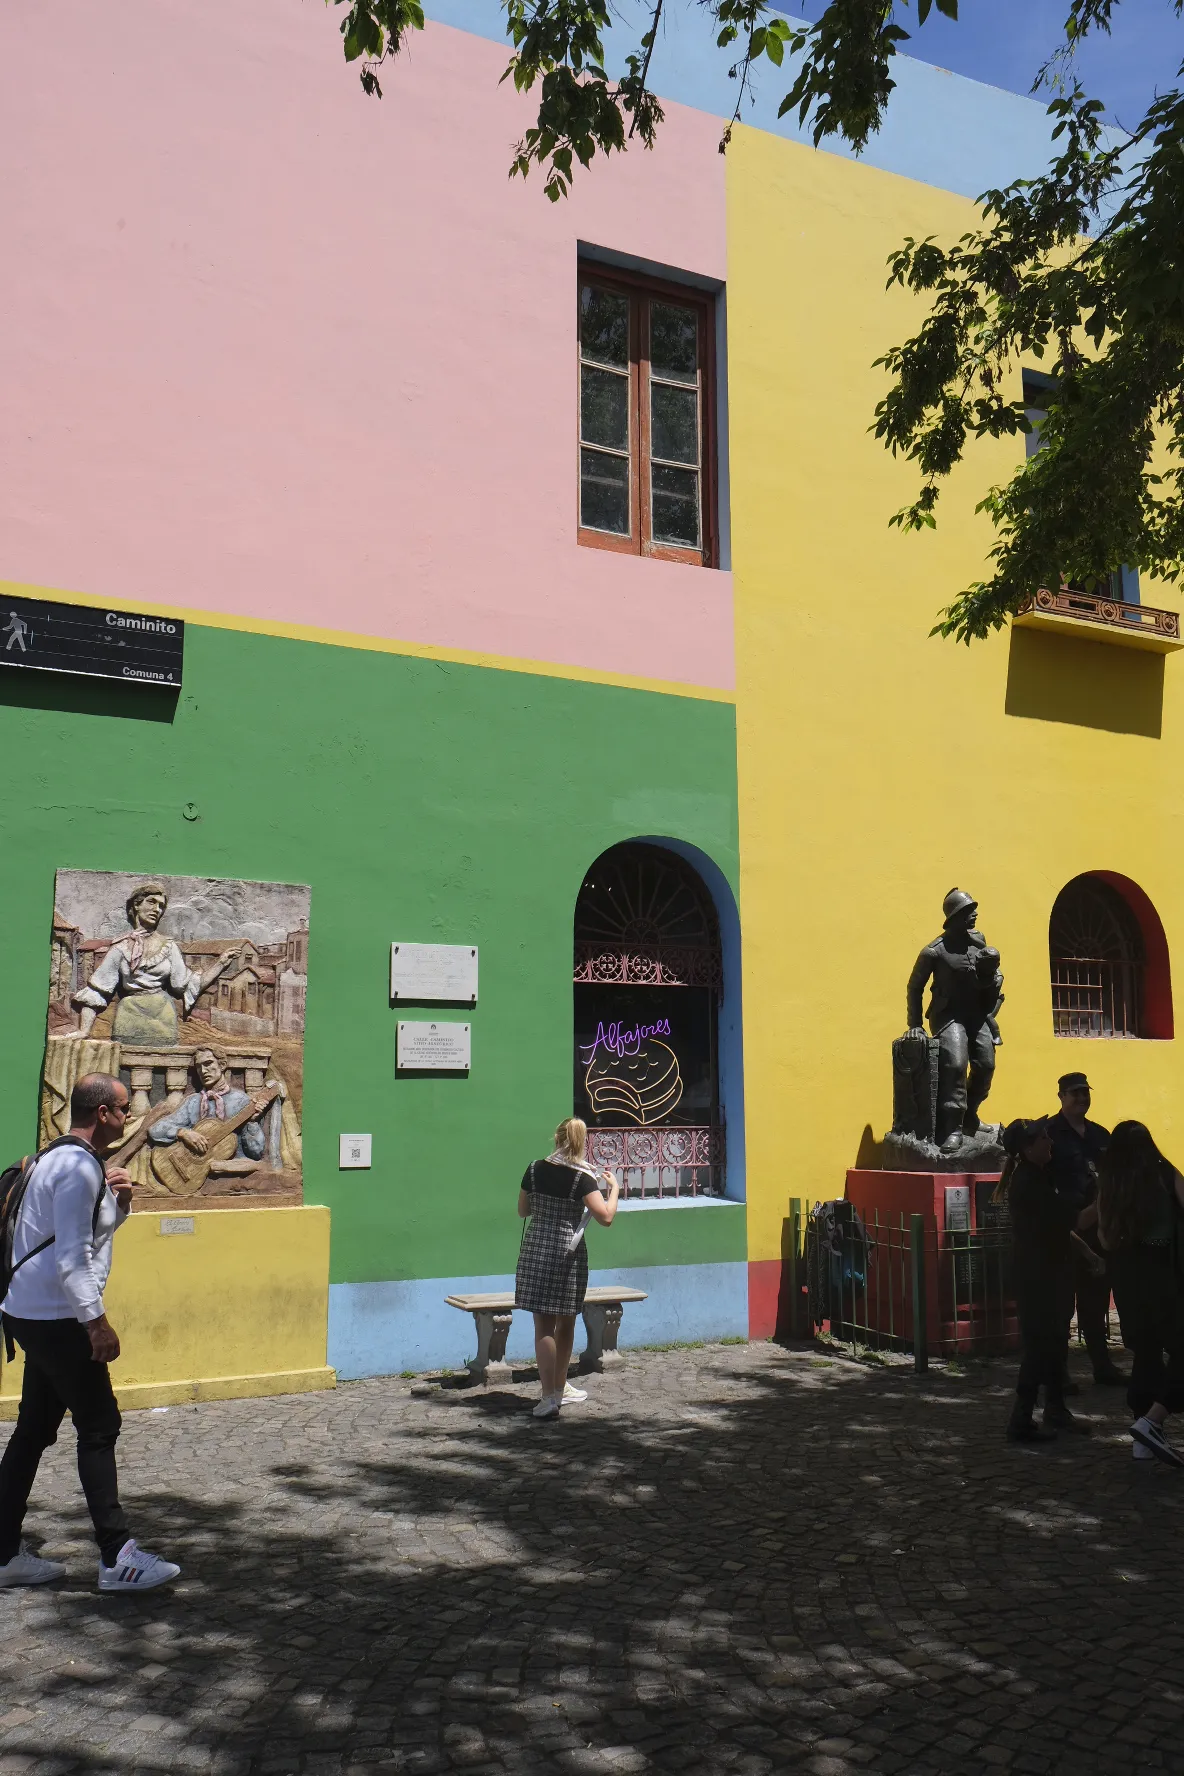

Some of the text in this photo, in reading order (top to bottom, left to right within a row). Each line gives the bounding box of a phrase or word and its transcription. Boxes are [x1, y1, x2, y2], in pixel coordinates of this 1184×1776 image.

[105, 612, 176, 634] Caminito
[122, 666, 174, 681] Comuna 4
[579, 1019, 671, 1065] Alfajores
